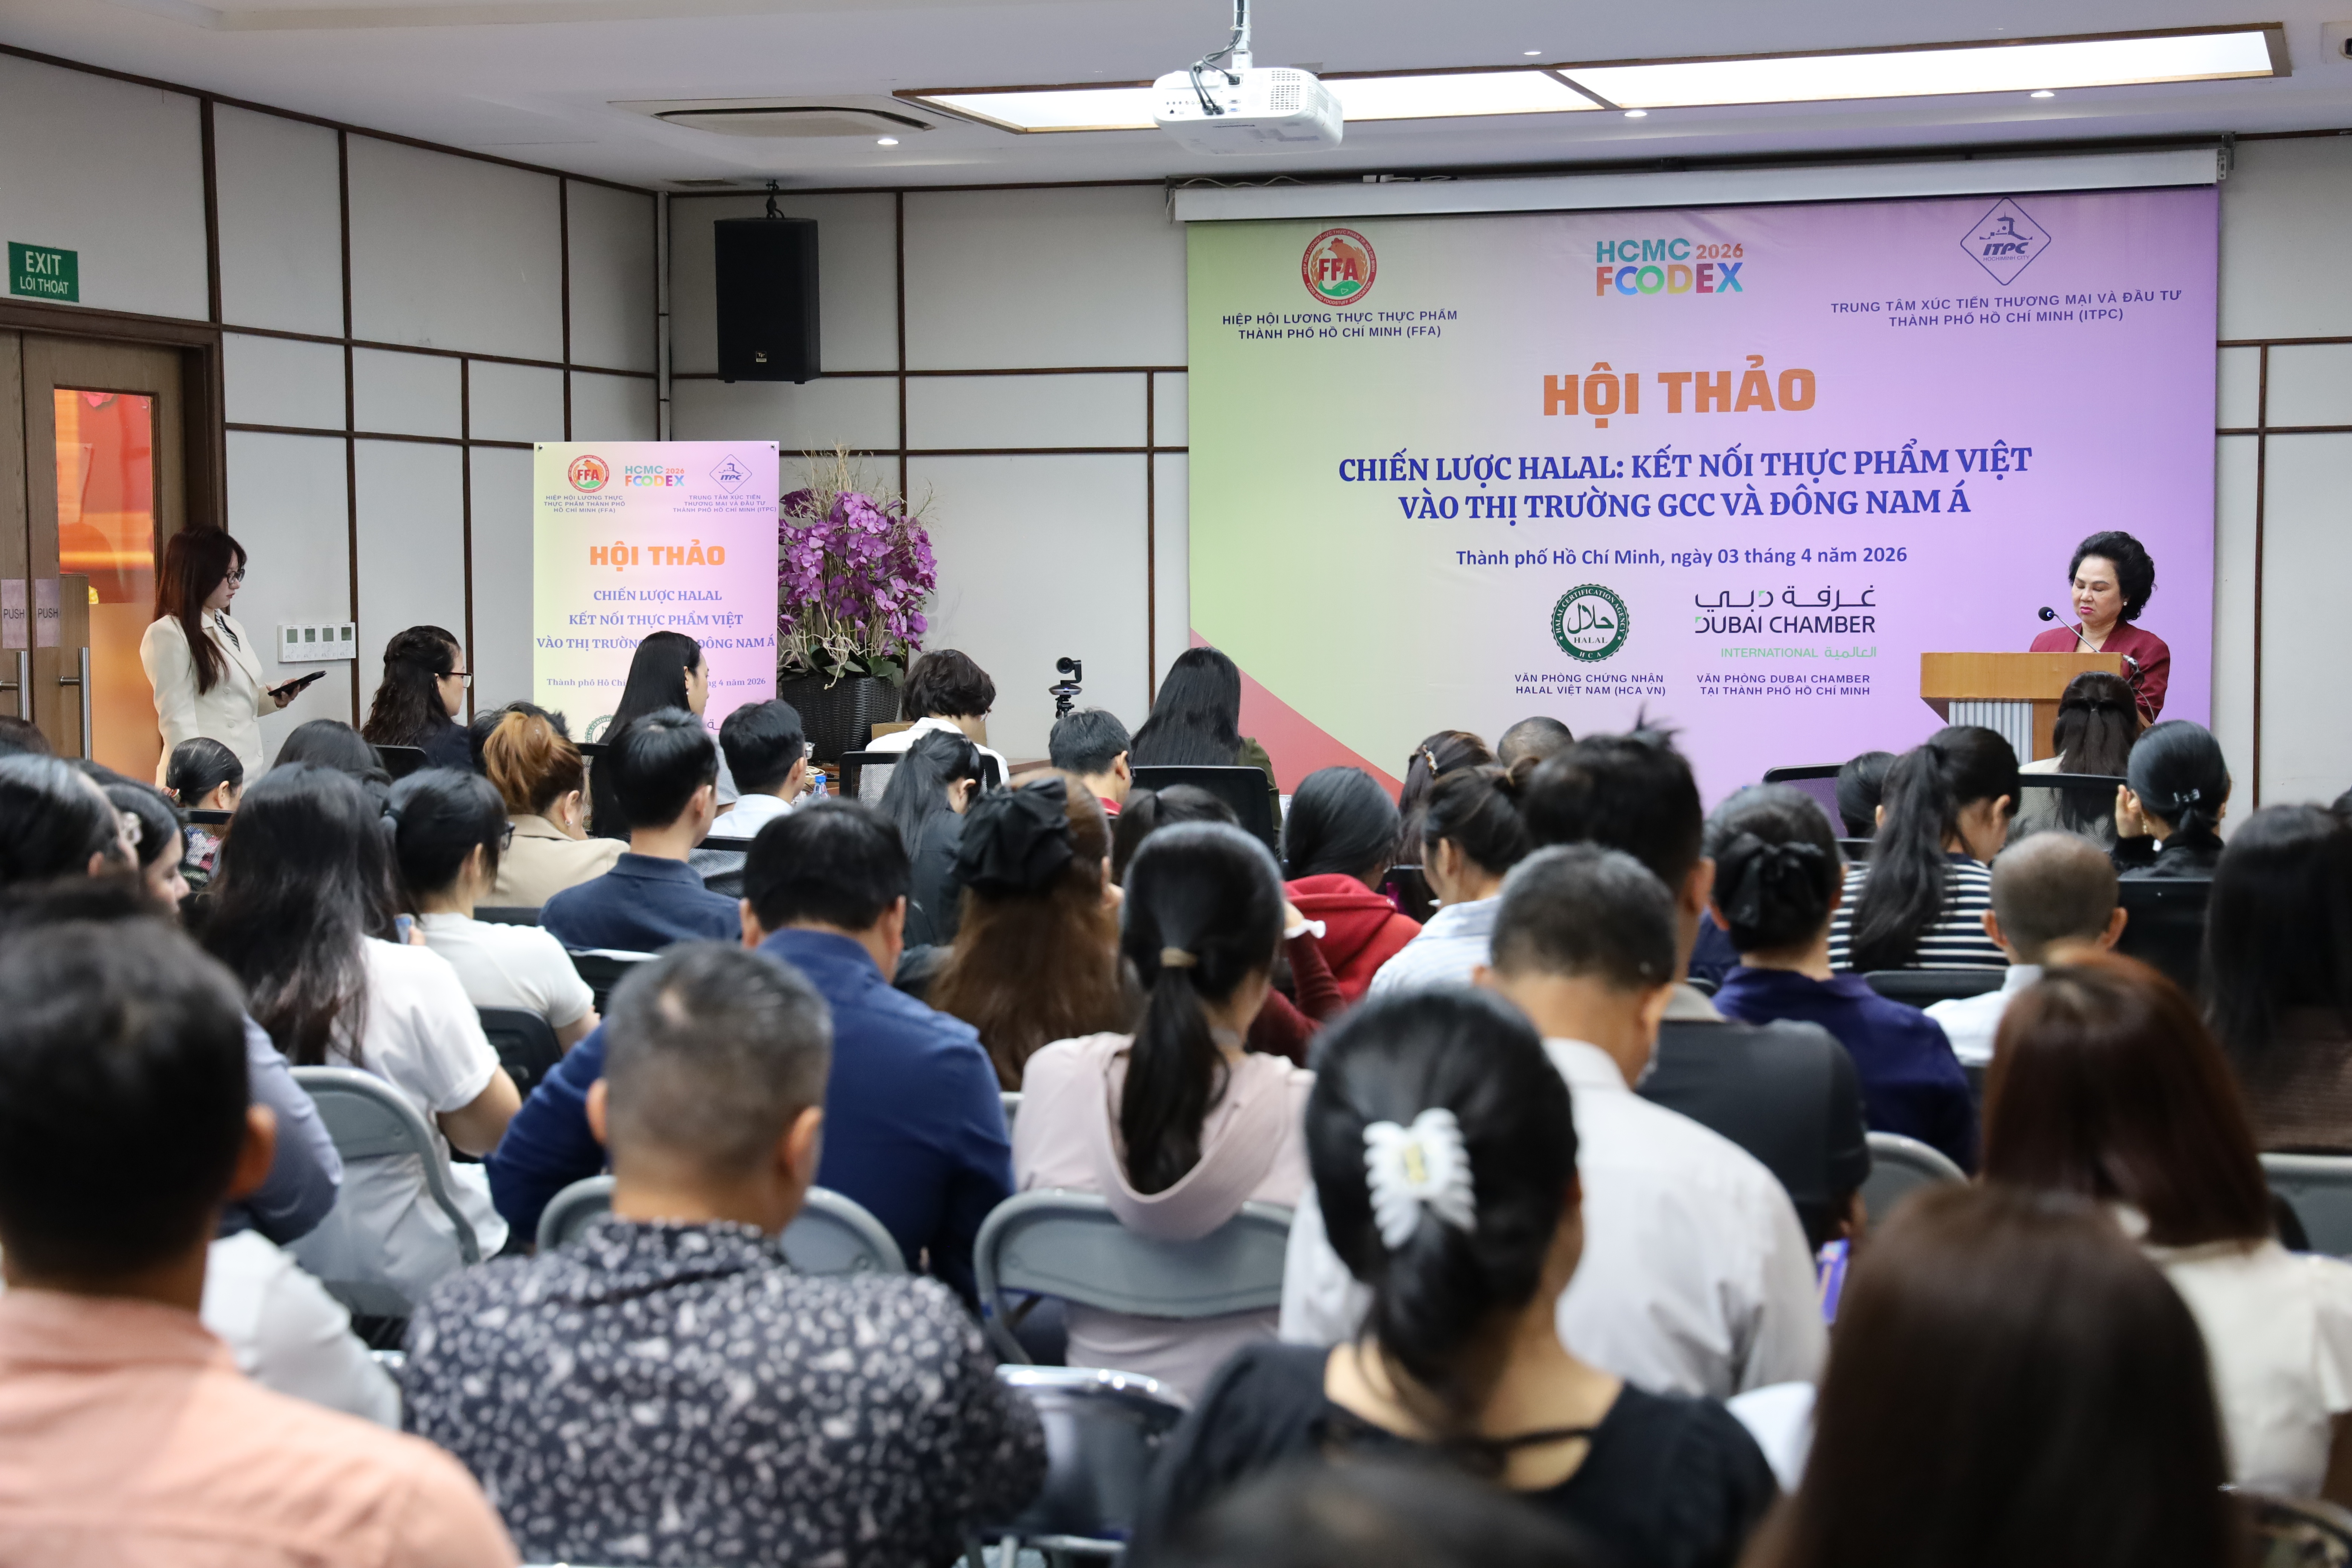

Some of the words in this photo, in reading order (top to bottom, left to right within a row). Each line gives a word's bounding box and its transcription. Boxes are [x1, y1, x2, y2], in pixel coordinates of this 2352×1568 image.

[1597, 238, 1690, 263] HCMC
[1697, 243, 1743, 259] 2026
[1983, 242, 2029, 256] ITPC
[26, 251, 61, 275] EXIT
[1319, 258, 1359, 281] FFA
[1307, 283, 1315, 295] FOOD
[1315, 292, 1323, 300] AND
[1349, 282, 1372, 302] ASSOCIATION
[1831, 302, 1880, 312] TRUNG
[1886, 299, 1915, 311] TÂM
[1922, 297, 1950, 309] XÚC
[1956, 296, 1988, 308] TIẾN
[1994, 296, 2059, 307] THƯƠNG
[2066, 294, 2091, 306] MẠI
[2098, 291, 2116, 303] VÀ
[2123, 289, 2154, 302] ĐẦU
[2160, 290, 2181, 300] TƯ
[1223, 313, 1251, 326] HIỆP
[1257, 312, 1278, 326] HỘI
[1284, 314, 1331, 323] LƯƠNG
[1337, 312, 1372, 324] THỰC
[1378, 312, 1414, 323] THỰC
[1420, 308, 1456, 320] PHẨM
[1889, 314, 1938, 326] THÀNH
[1945, 312, 1974, 325] PHỐ
[1980, 311, 2000, 323] HỒ
[2006, 310, 2031, 322] CHÍ
[2037, 311, 2073, 321] MINH
[2079, 308, 2123, 322] (ITPC)
[1239, 328, 1282, 339] THÀNH
[1288, 327, 1314, 338] PHỐ
[1320, 326, 1337, 337] HỒ
[1343, 326, 1364, 337] CHÍ
[1370, 327, 1401, 336] MINH
[1407, 326, 1440, 338] (FFA)
[1544, 362, 1638, 428] HỘI
[1658, 355, 1815, 413] THẢO
[625, 466, 663, 474] HCMC
[1340, 448, 1429, 481] CHIẾN
[1436, 454, 1511, 488] LƯỢC
[1519, 456, 1623, 479] HALAL:
[1632, 444, 1692, 478] KẾT
[1699, 443, 1753, 477] NỐI
[1761, 449, 1846, 484] THỰC
[1854, 438, 1949, 474] PHẨM
[1955, 439, 2032, 480] VIỆT
[577, 469, 599, 481] FFA
[1398, 487, 1458, 519] VÀO
[1465, 496, 1517, 526] THỊ
[1524, 485, 1651, 518] TRƯỜNG
[1658, 493, 1715, 517] GCC
[1720, 483, 1764, 516] VÀ
[1770, 484, 1858, 515] ĐÔNG
[1866, 490, 1940, 514] NAM
[1947, 479, 1971, 512] Á
[590, 541, 638, 571] HỘI
[648, 539, 725, 565] THẢO
[1456, 550, 1508, 565] Thành
[1515, 548, 1547, 568] phố
[1554, 548, 1576, 564] Hồ
[1582, 550, 1609, 564] Chí
[1615, 549, 1664, 566] Minh,
[1672, 549, 1712, 567] ngày
[1718, 549, 1738, 563] 03
[1744, 548, 1795, 566] tháng
[1801, 549, 1811, 562] 4
[1818, 547, 1856, 562] năm
[1864, 547, 1906, 562] 2026
[594, 586, 636, 600] CHIẾN
[640, 590, 674, 603] LƯỢC
[678, 591, 722, 600] HALAL
[1695, 590, 1773, 612] دبي
[1782, 585, 1876, 611] غرفة
[4, 609, 24, 619] PUSH
[38, 608, 58, 618] PUSH
[570, 611, 596, 625] KẾT
[600, 611, 624, 625] NỐI
[628, 614, 665, 628] THỰC
[669, 611, 709, 625] PHẨM
[712, 611, 743, 628] VIỆT
[1556, 608, 1564, 634] HALAL
[1562, 589, 1615, 607] CERTIFICATION
[1613, 603, 1625, 634] AGENCY
[1567, 602, 1614, 634] حلال
[1695, 616, 1761, 633] DUBAI
[1770, 616, 1875, 633] CHAMBER
[536, 635, 563, 648] VÀO
[566, 639, 588, 651] THỊ
[736, 638, 764, 648] NAM
[767, 634, 775, 646] Á
[1721, 648, 1818, 657] INTERNATIONAL
[1825, 646, 1877, 660] العالمية
[1515, 673, 1537, 682] VĂN
[1542, 673, 1581, 682] PHÒNG
[1586, 673, 1626, 682] CHỨNG
[1632, 673, 1663, 684] NHẬN
[1697, 673, 1720, 682] VĂN
[1725, 673, 1765, 683] PHÒNG
[1557, 684, 1581, 696] VIỆT
[1615, 687, 1642, 696] (HCA
[1647, 687, 1665, 696] VN)
[1700, 687, 1718, 696] TẠI
[1723, 685, 1762, 694] THÀNH
[1767, 685, 1790, 695] PHỐ
[1796, 686, 1811, 695] HỒ
[1816, 685, 1836, 695] CHÍ
